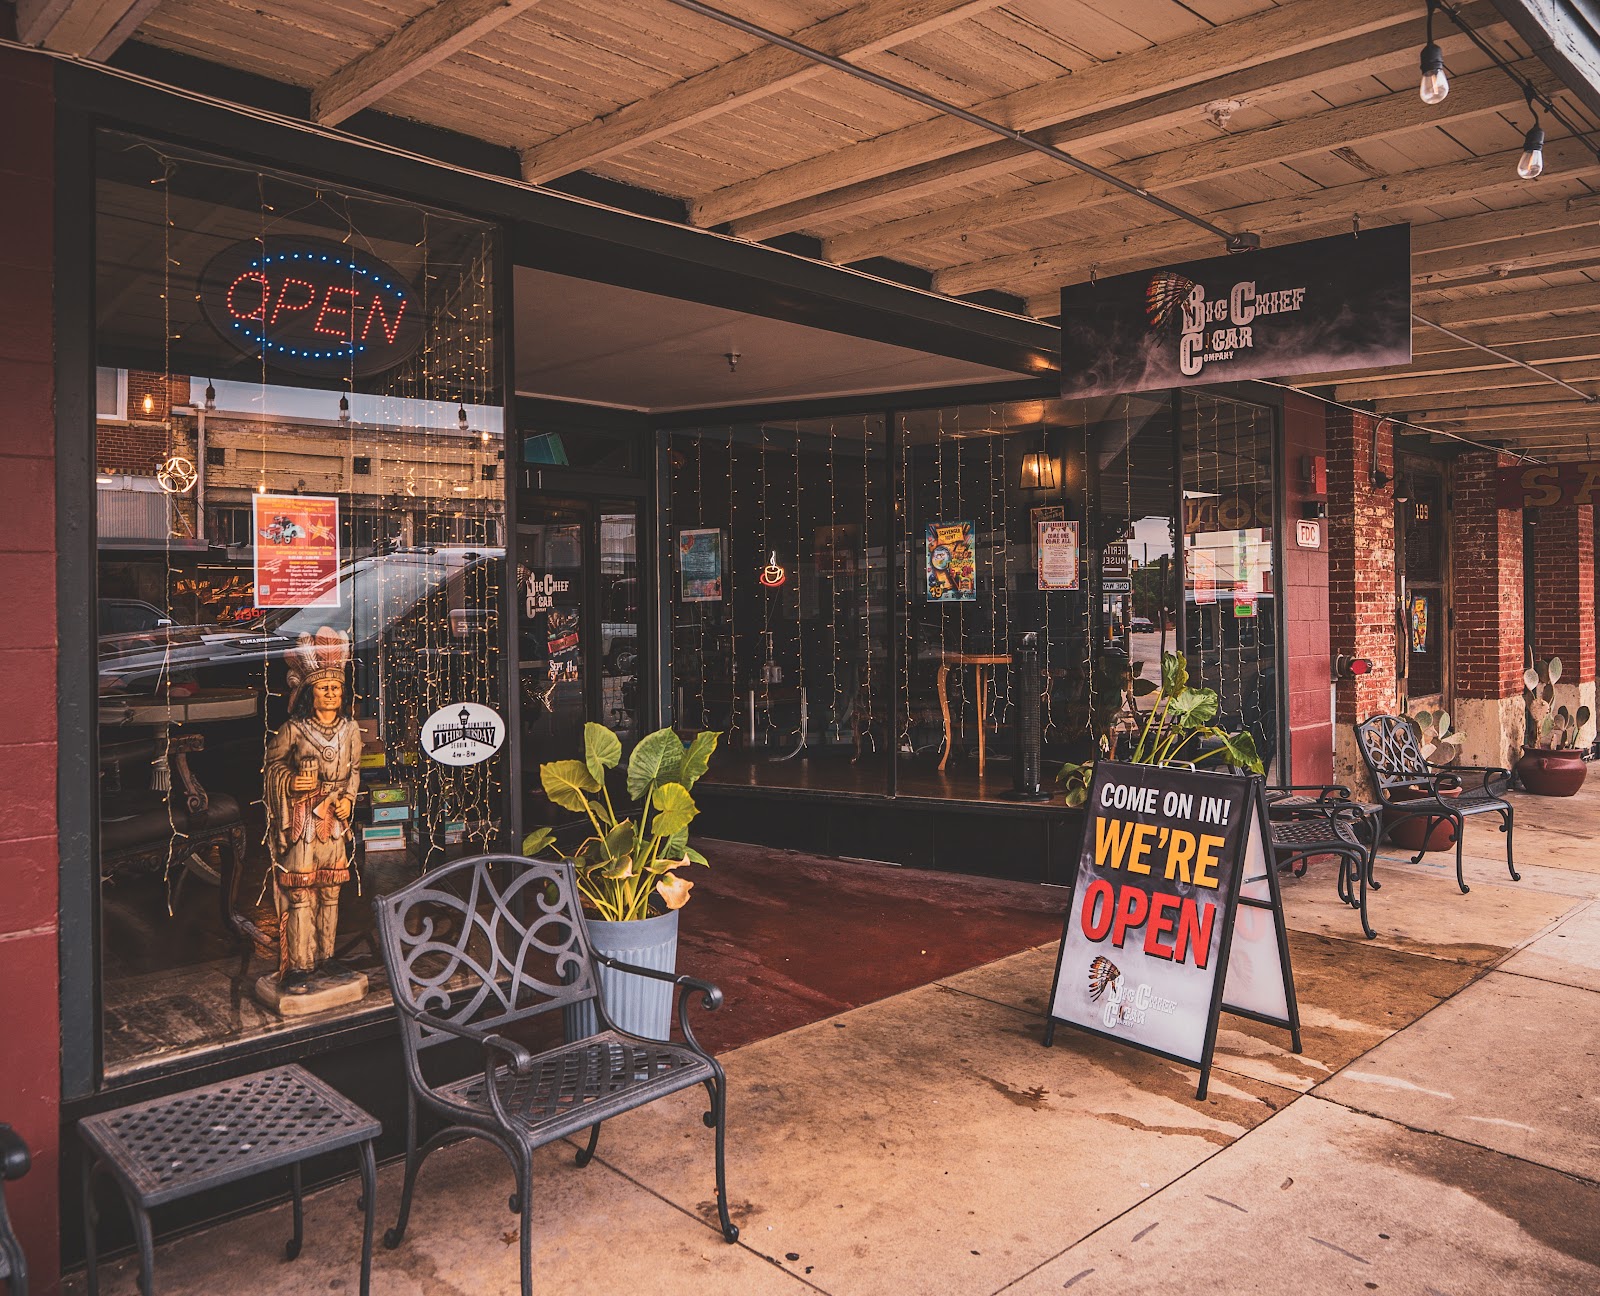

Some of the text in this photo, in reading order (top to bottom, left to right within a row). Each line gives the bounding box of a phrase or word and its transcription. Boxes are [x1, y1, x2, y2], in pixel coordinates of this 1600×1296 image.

[226, 270, 408, 344] OPEN
[1180, 280, 1306, 335] BIG CHIEF
[1415, 503, 1429, 520] 109
[939, 528, 961, 537] SCAVENGER
[1300, 525, 1316, 542] FDC
[544, 574, 569, 596] CHIEF
[930, 586, 943, 598] 19
[434, 729, 463, 748] THIRD
[1100, 782, 1232, 826] COME ON IN!
[1094, 816, 1226, 889] WE'RE
[1080, 879, 1217, 970] OPEN
[1135, 983, 1178, 1014] CHIEF
